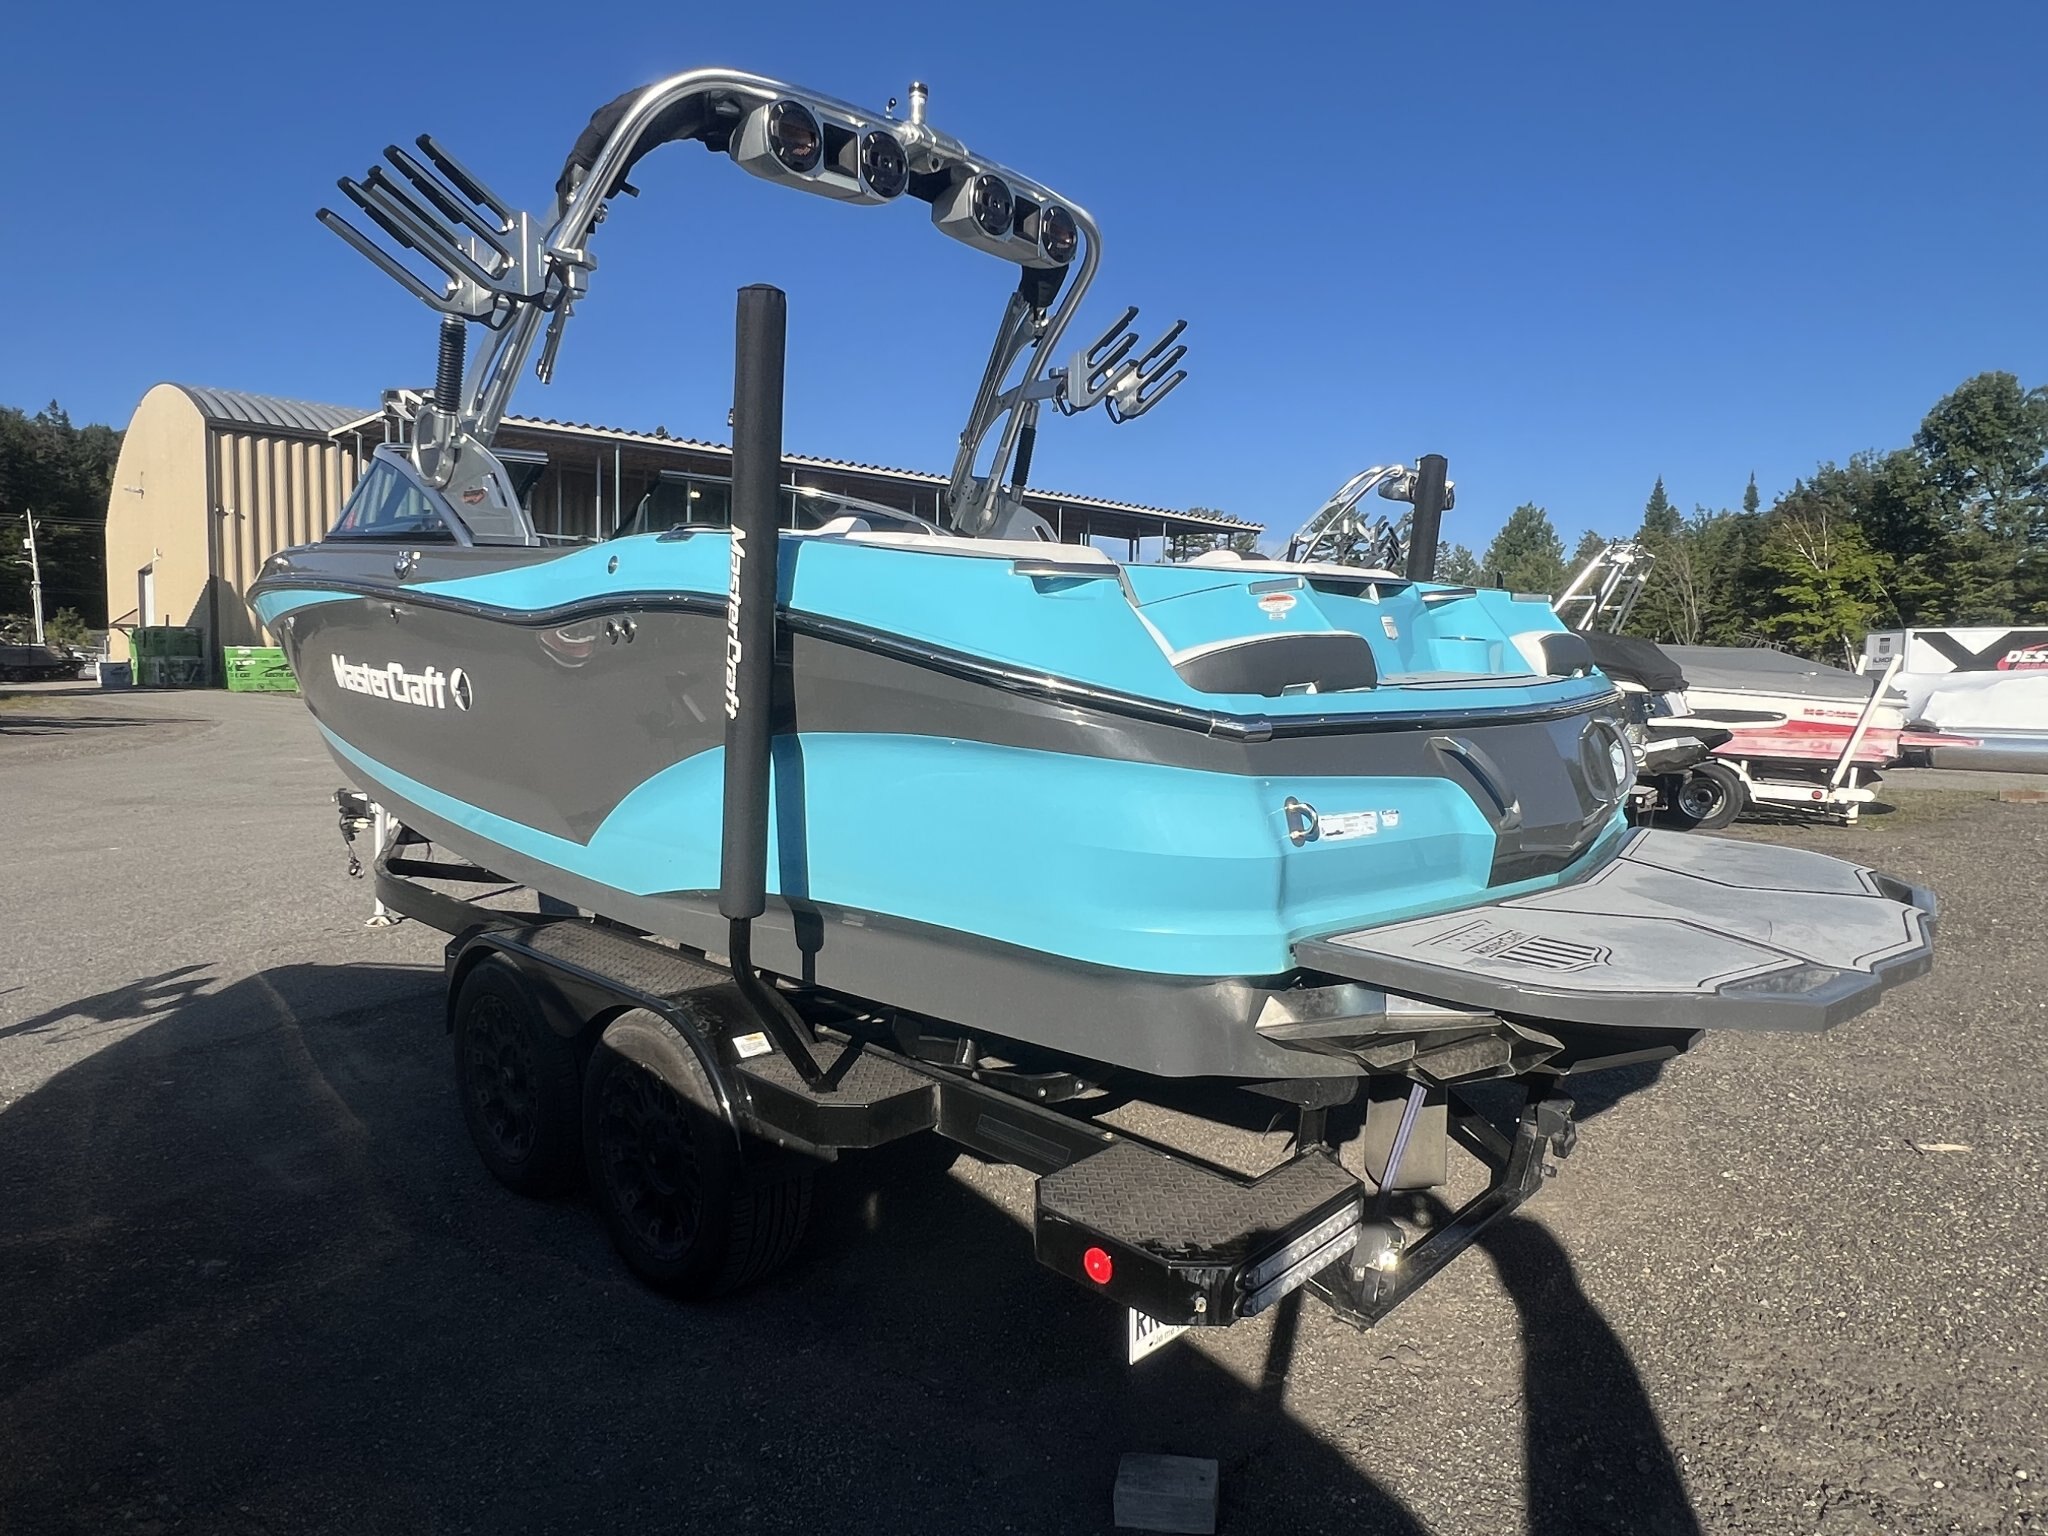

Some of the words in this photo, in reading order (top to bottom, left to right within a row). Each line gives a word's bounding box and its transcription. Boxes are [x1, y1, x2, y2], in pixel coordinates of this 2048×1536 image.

[725, 524, 747, 720] MasterCraft
[331, 653, 446, 709] MasterCraft
[2004, 650, 2048, 663] DES
